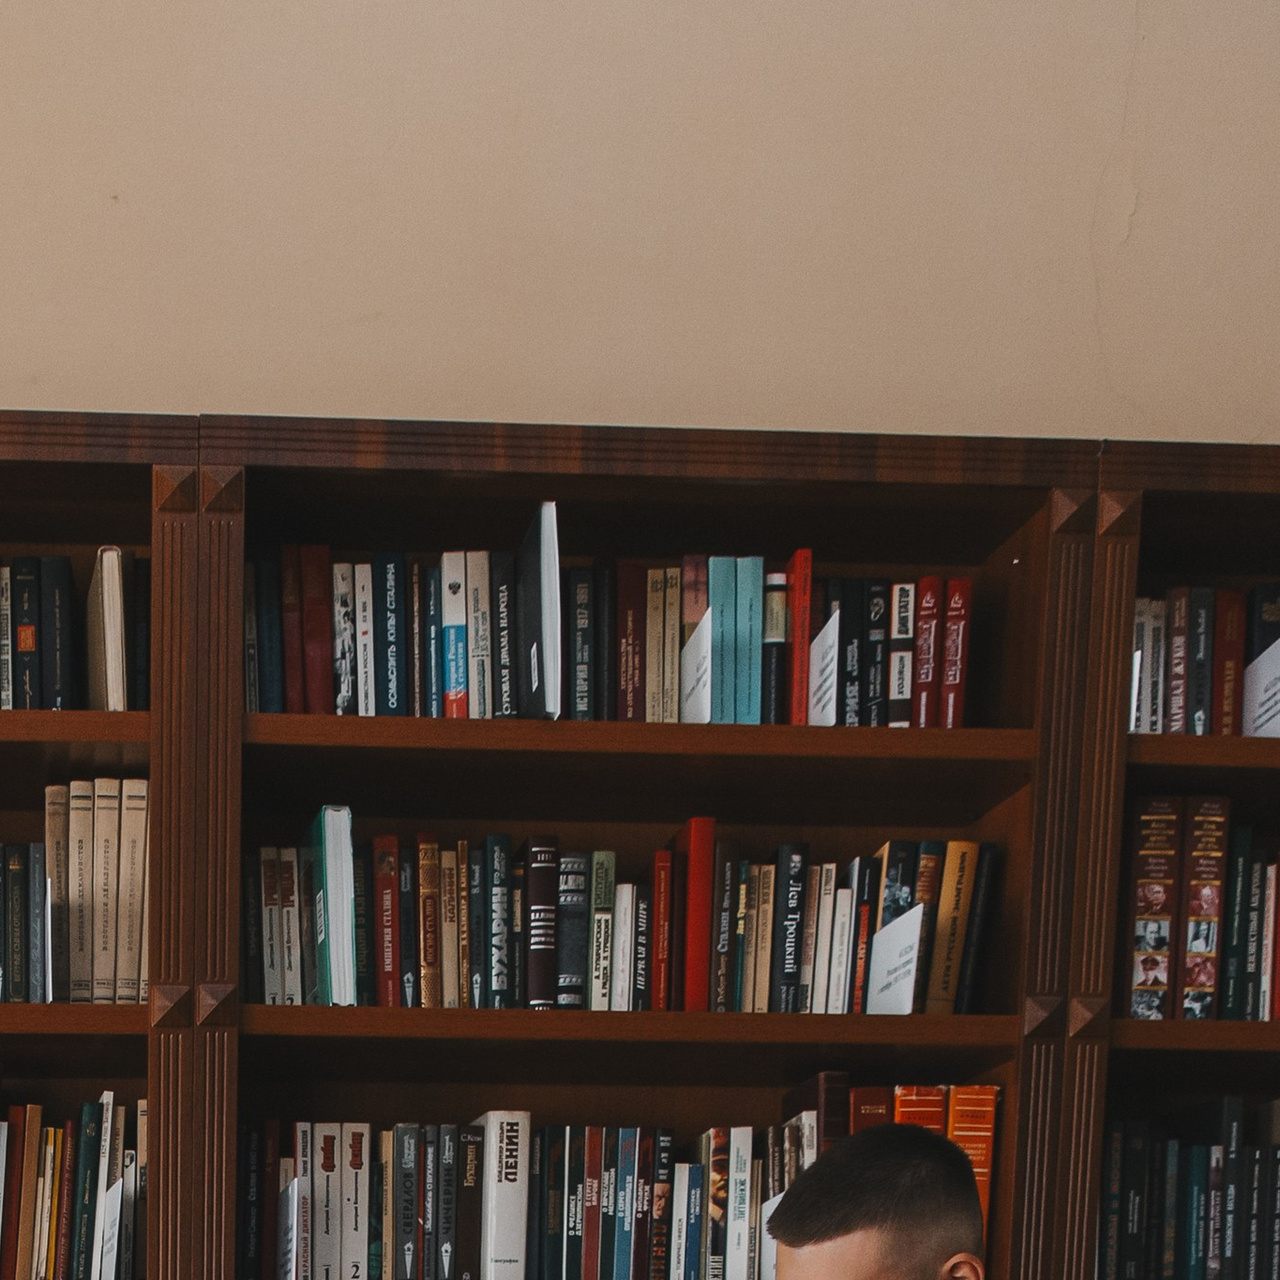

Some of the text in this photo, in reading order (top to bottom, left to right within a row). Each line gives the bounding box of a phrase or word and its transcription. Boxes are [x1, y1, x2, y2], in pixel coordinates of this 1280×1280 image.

[387, 563, 395, 609] СТАЛИНА
[499, 585, 508, 627] НАРОДА
[388, 645, 397, 708] ОСМЫСЛИТЬ
[502, 669, 511, 714] СУРОВАЯ
[447, 868, 455, 922] КАЛИНИН
[383, 928, 392, 972] ИМПЕРИЯ
[491, 886, 508, 990] БУХАРИН
[783, 880, 802, 972] Лев Троцкий
[463, 1145, 477, 1186] Бухарин
[504, 1122, 519, 1183] ЛЕНИН
[402, 1172, 414, 1235] СВЕРДЛОВ
[443, 1168, 453, 1234] ЧИЧЕРИН
[301, 1196, 309, 1273] КРАСНЫЙ ДИКТАТОР
